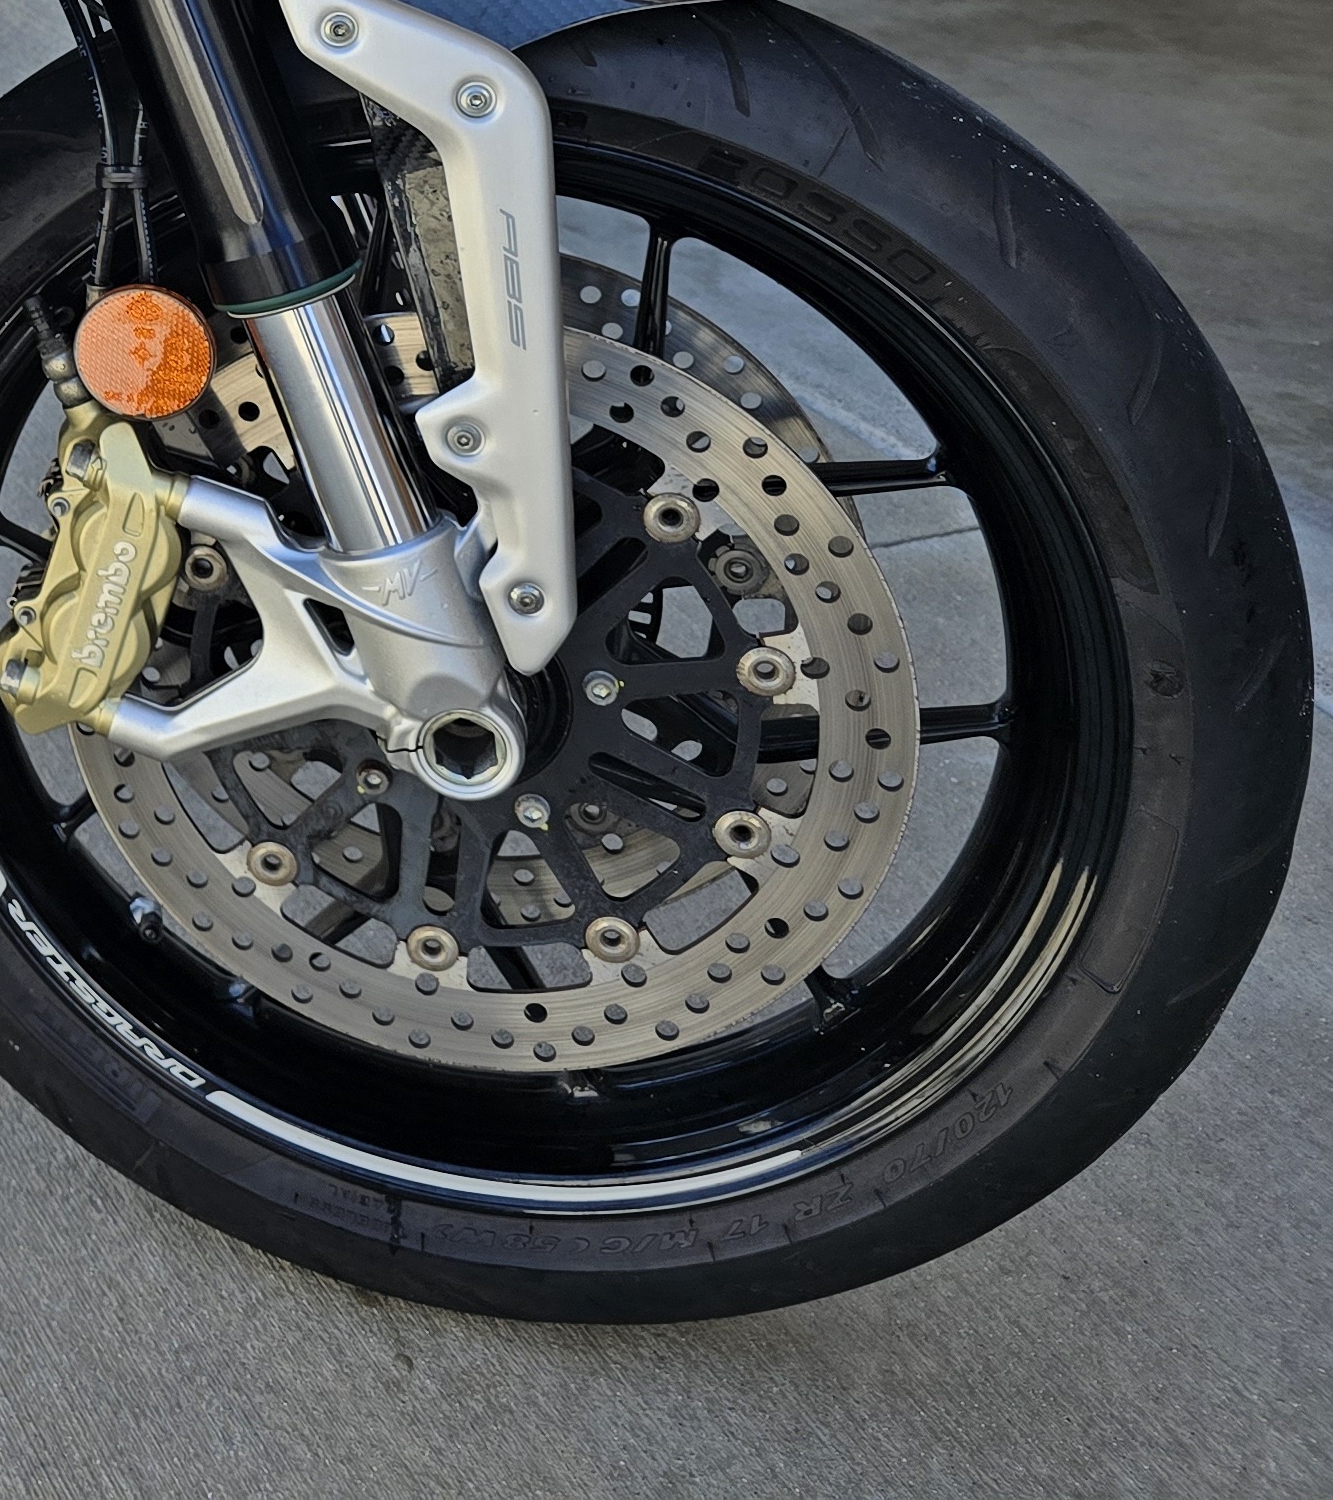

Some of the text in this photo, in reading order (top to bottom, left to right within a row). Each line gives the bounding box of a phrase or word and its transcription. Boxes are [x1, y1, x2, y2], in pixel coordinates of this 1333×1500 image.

[499, 207, 527, 351] ABS
[71, 541, 137, 668] brembo
[7, 898, 207, 1090] DRAGSTER
[879, 1082, 1013, 1184] 120/70
[597, 1228, 700, 1256] M/C
[718, 1213, 770, 1245] 17
[793, 1182, 852, 1223] ZR
